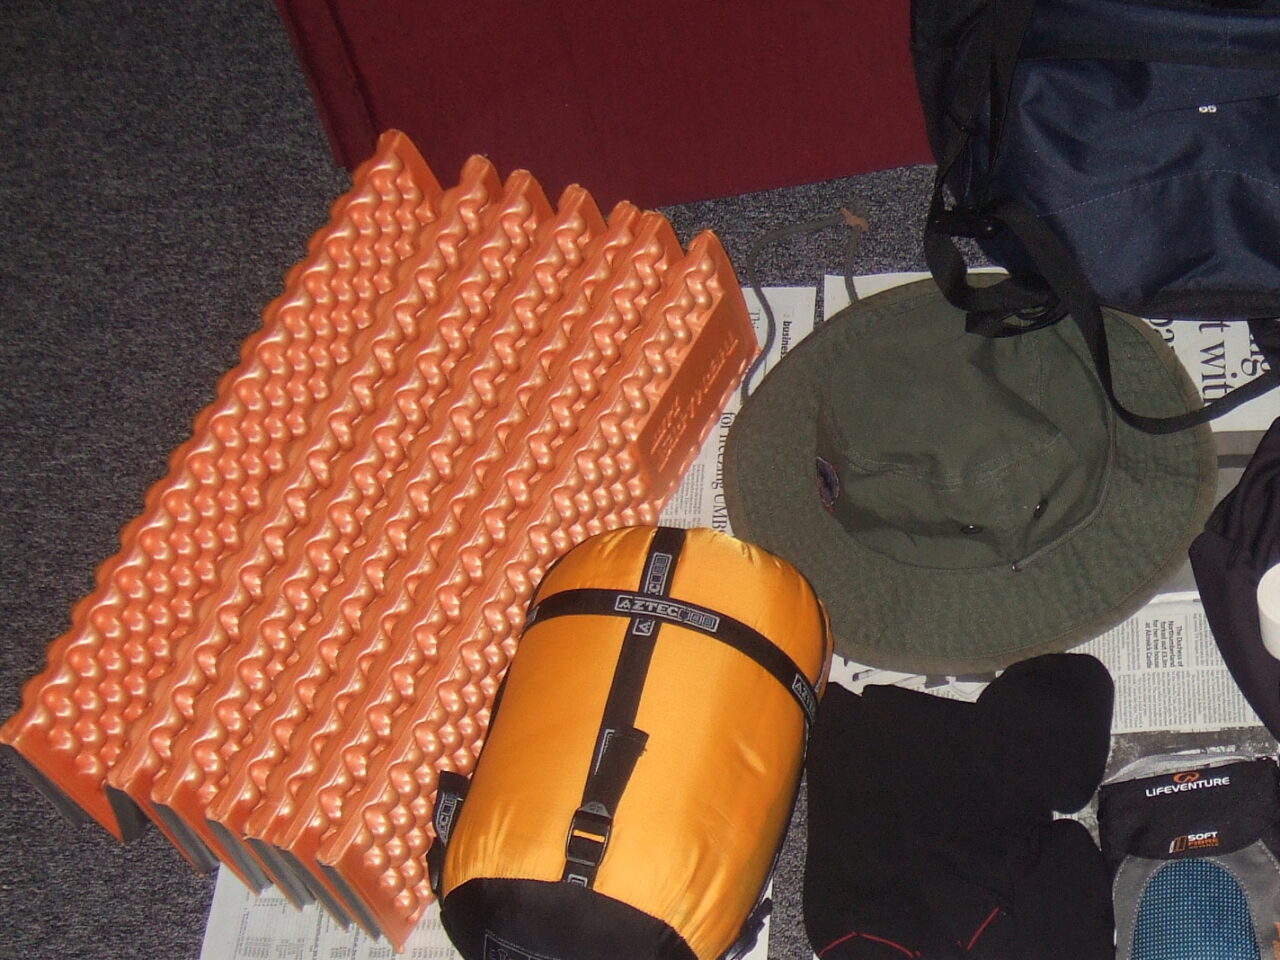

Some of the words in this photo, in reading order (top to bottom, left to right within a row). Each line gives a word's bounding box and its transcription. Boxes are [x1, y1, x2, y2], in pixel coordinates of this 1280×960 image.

[619, 599, 679, 618] AZTEC
[1145, 776, 1231, 797] LIFEVENTURE
[1188, 831, 1218, 841] SOFT
